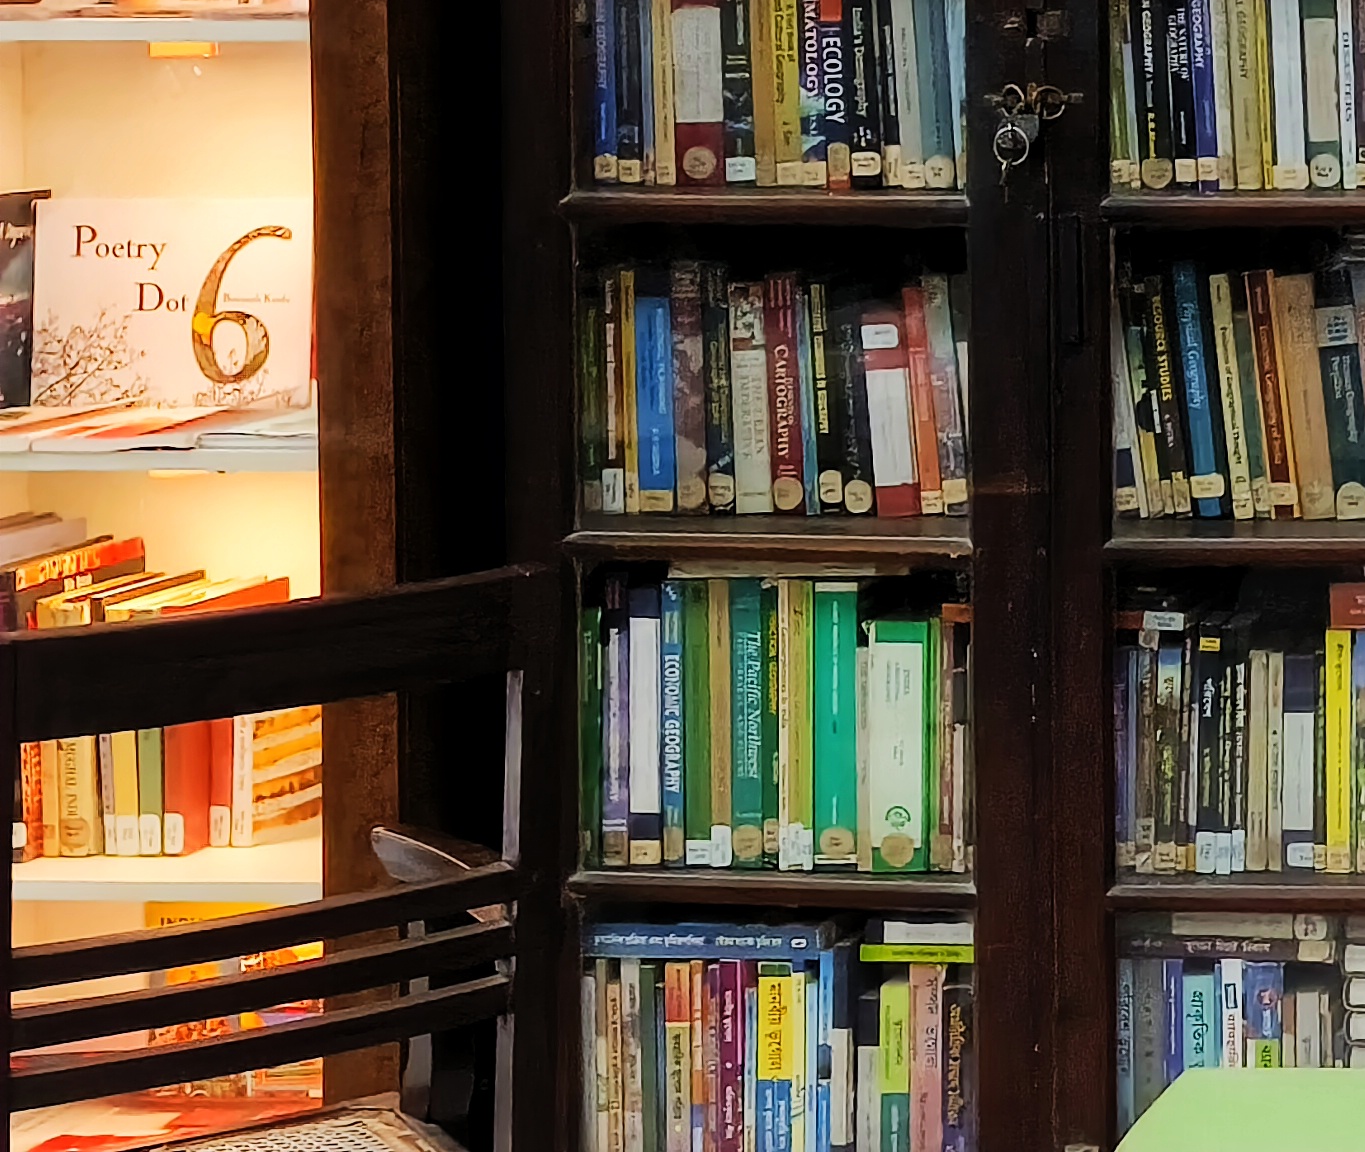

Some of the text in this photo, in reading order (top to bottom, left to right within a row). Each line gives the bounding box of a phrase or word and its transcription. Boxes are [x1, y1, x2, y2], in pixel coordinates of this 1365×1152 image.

[1142, 10, 1154, 74] GEOGRAPHY
[821, 36, 847, 125] ECOLOGY
[71, 224, 169, 271] Poetry
[134, 281, 190, 313] Dot
[773, 344, 790, 458] CARTOGRAPHY
[1158, 354, 1174, 401] STUDIES
[664, 654, 682, 794] ECONOMIC GEOGRAPHY
[746, 631, 762, 780] The Pacific Northwest
